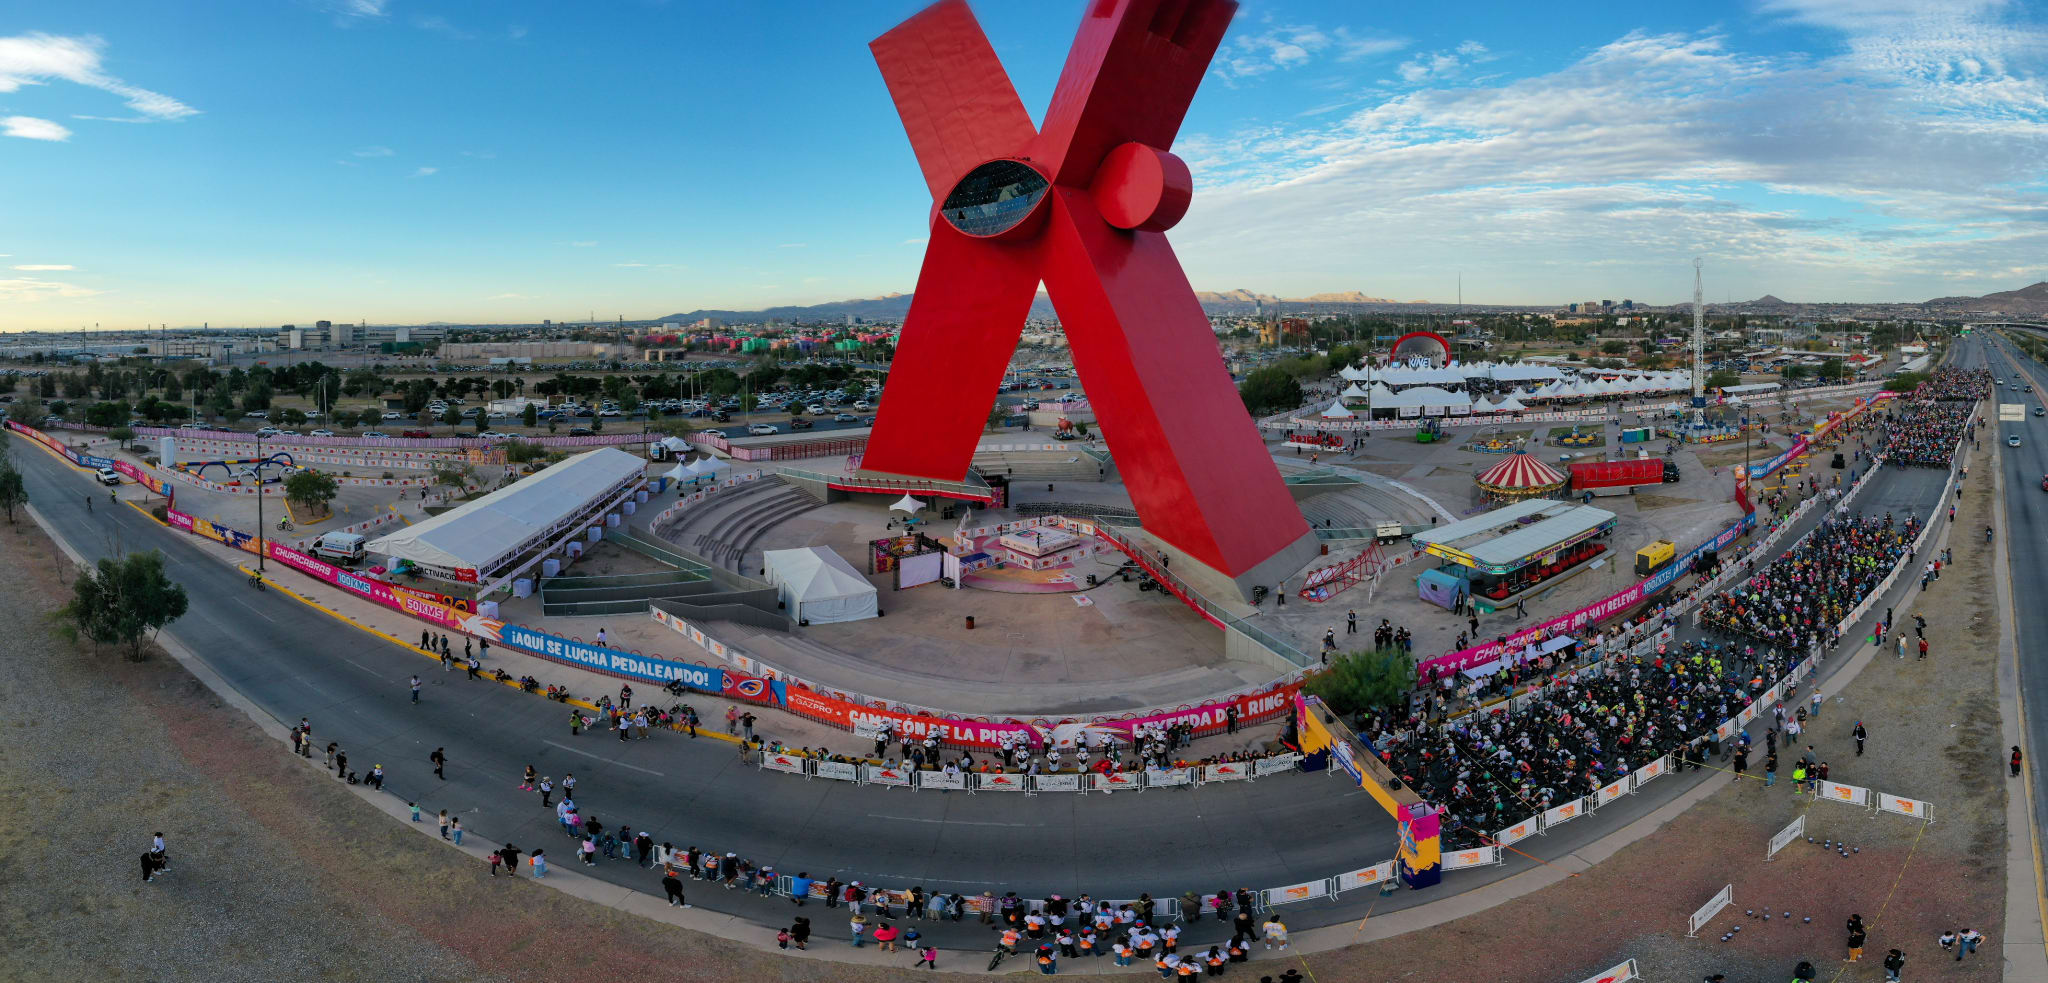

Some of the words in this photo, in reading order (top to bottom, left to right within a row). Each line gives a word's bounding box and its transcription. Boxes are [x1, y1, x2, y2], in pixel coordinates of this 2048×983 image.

[275, 547, 332, 576] CHUPACABRAS
[1607, 588, 1638, 612] RELEVO!
[512, 630, 544, 651] ¡AQUÍ
[547, 640, 562, 656] SE
[565, 645, 608, 667] LUCHA
[611, 655, 709, 687] PEDALEANDO!
[796, 698, 833, 714] GAZPRO
[1216, 704, 1246, 723] DL
[1248, 693, 1285, 716] RING
[954, 726, 975, 742] LA
